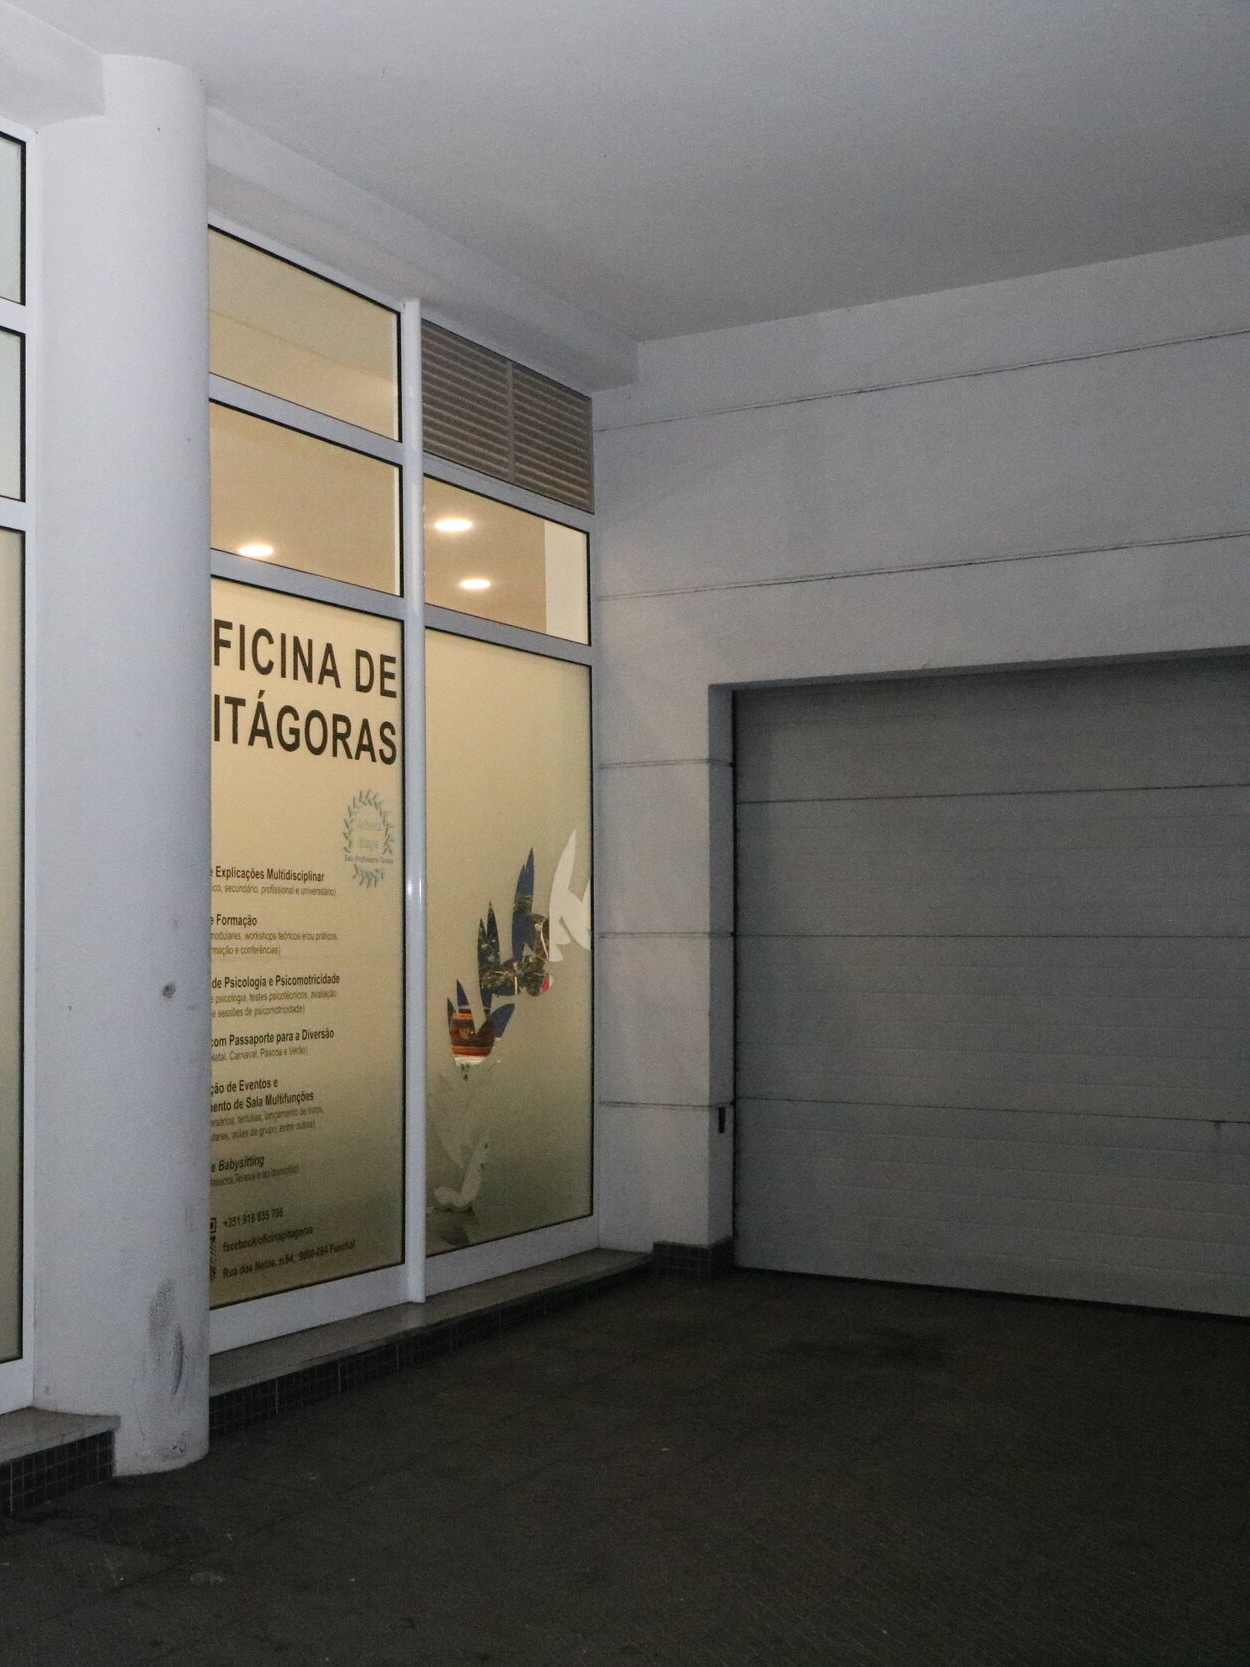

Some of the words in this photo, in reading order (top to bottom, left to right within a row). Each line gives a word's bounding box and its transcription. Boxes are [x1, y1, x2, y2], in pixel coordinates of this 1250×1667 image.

[214, 619, 341, 688] FICINA
[355, 649, 397, 698] DE
[214, 690, 397, 765] ITÁGORAS
[216, 866, 264, 881] Explicações
[267, 869, 325, 883] Multidisciplinar
[261, 886, 295, 895] profissional
[217, 914, 257, 928] Formação
[212, 978, 222, 989] de
[225, 976, 267, 990] Psicologia
[276, 973, 340, 986] Psicomotricidade
[218, 1008, 243, 1017] sessões
[245, 1007, 252, 1016] de
[230, 1033, 274, 1047] Passaporte
[276, 1032, 293, 1044] para
[302, 1028, 334, 1041] Diversão
[227, 1082, 237, 1093] de
[239, 1079, 271, 1091] Eventos
[274, 1079, 278, 1087] e
[234, 1099, 244, 1110] de
[246, 1097, 263, 1109] Sala
[266, 1091, 314, 1106] Multifunções
[250, 1128, 258, 1137] de
[219, 1155, 265, 1172] Babysitting
[223, 1268, 238, 1279] Rua
[239, 1264, 253, 1274] dos
[330, 1239, 356, 1254] Funchal
